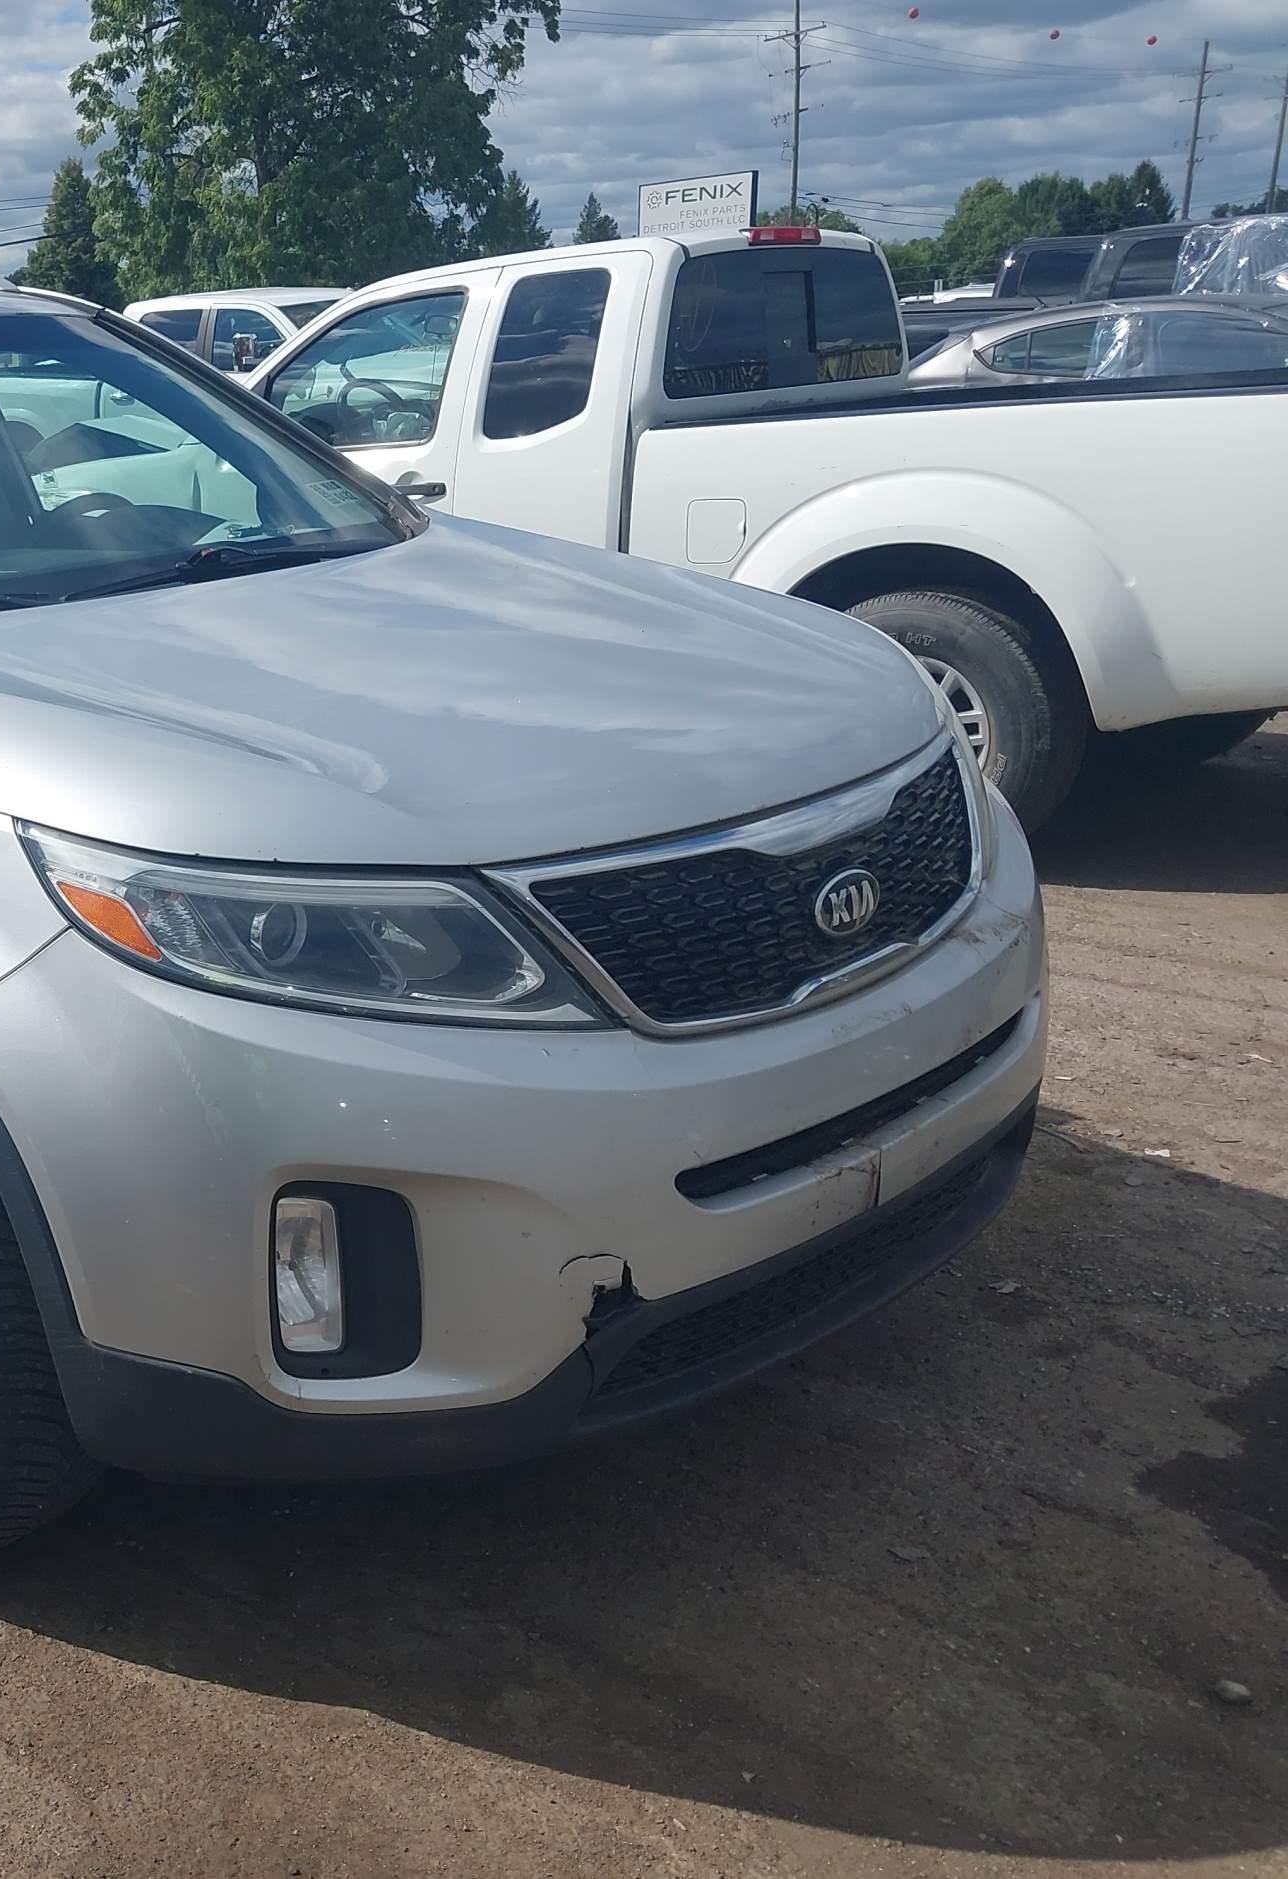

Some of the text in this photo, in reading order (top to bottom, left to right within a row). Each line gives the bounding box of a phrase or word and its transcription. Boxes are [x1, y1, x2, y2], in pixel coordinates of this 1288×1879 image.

[665, 182, 744, 206] FENIX
[679, 204, 746, 219] FENIX PARTS
[643, 214, 746, 234] DETROIT SOUTH LLC
[905, 631, 937, 646] HT
[828, 879, 874, 927] KIA
